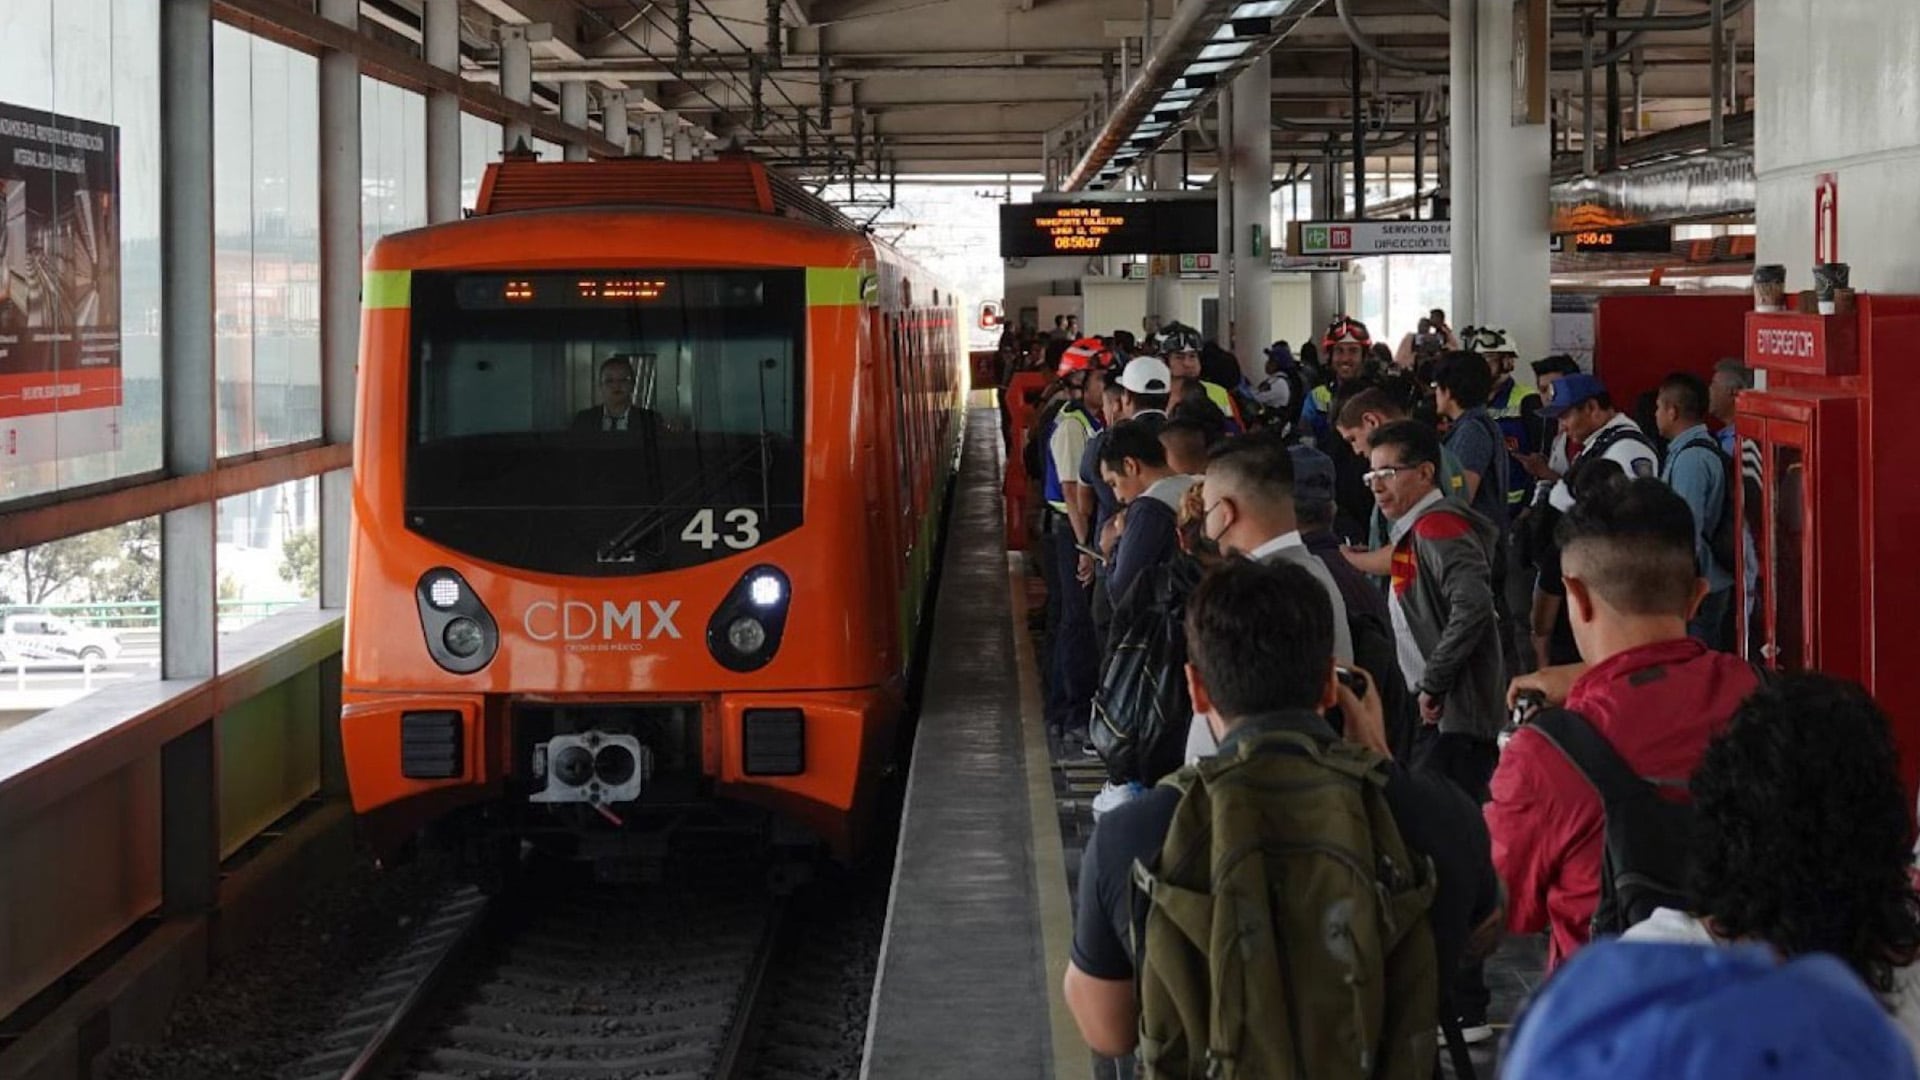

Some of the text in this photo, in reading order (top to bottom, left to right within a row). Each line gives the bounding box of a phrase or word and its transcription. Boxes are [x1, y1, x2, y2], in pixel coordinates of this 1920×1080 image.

[1382, 224, 1429, 234] SERVICIO
[1431, 224, 1444, 234] DE
[680, 508, 761, 550] 43
[524, 600, 682, 641] CDMX
